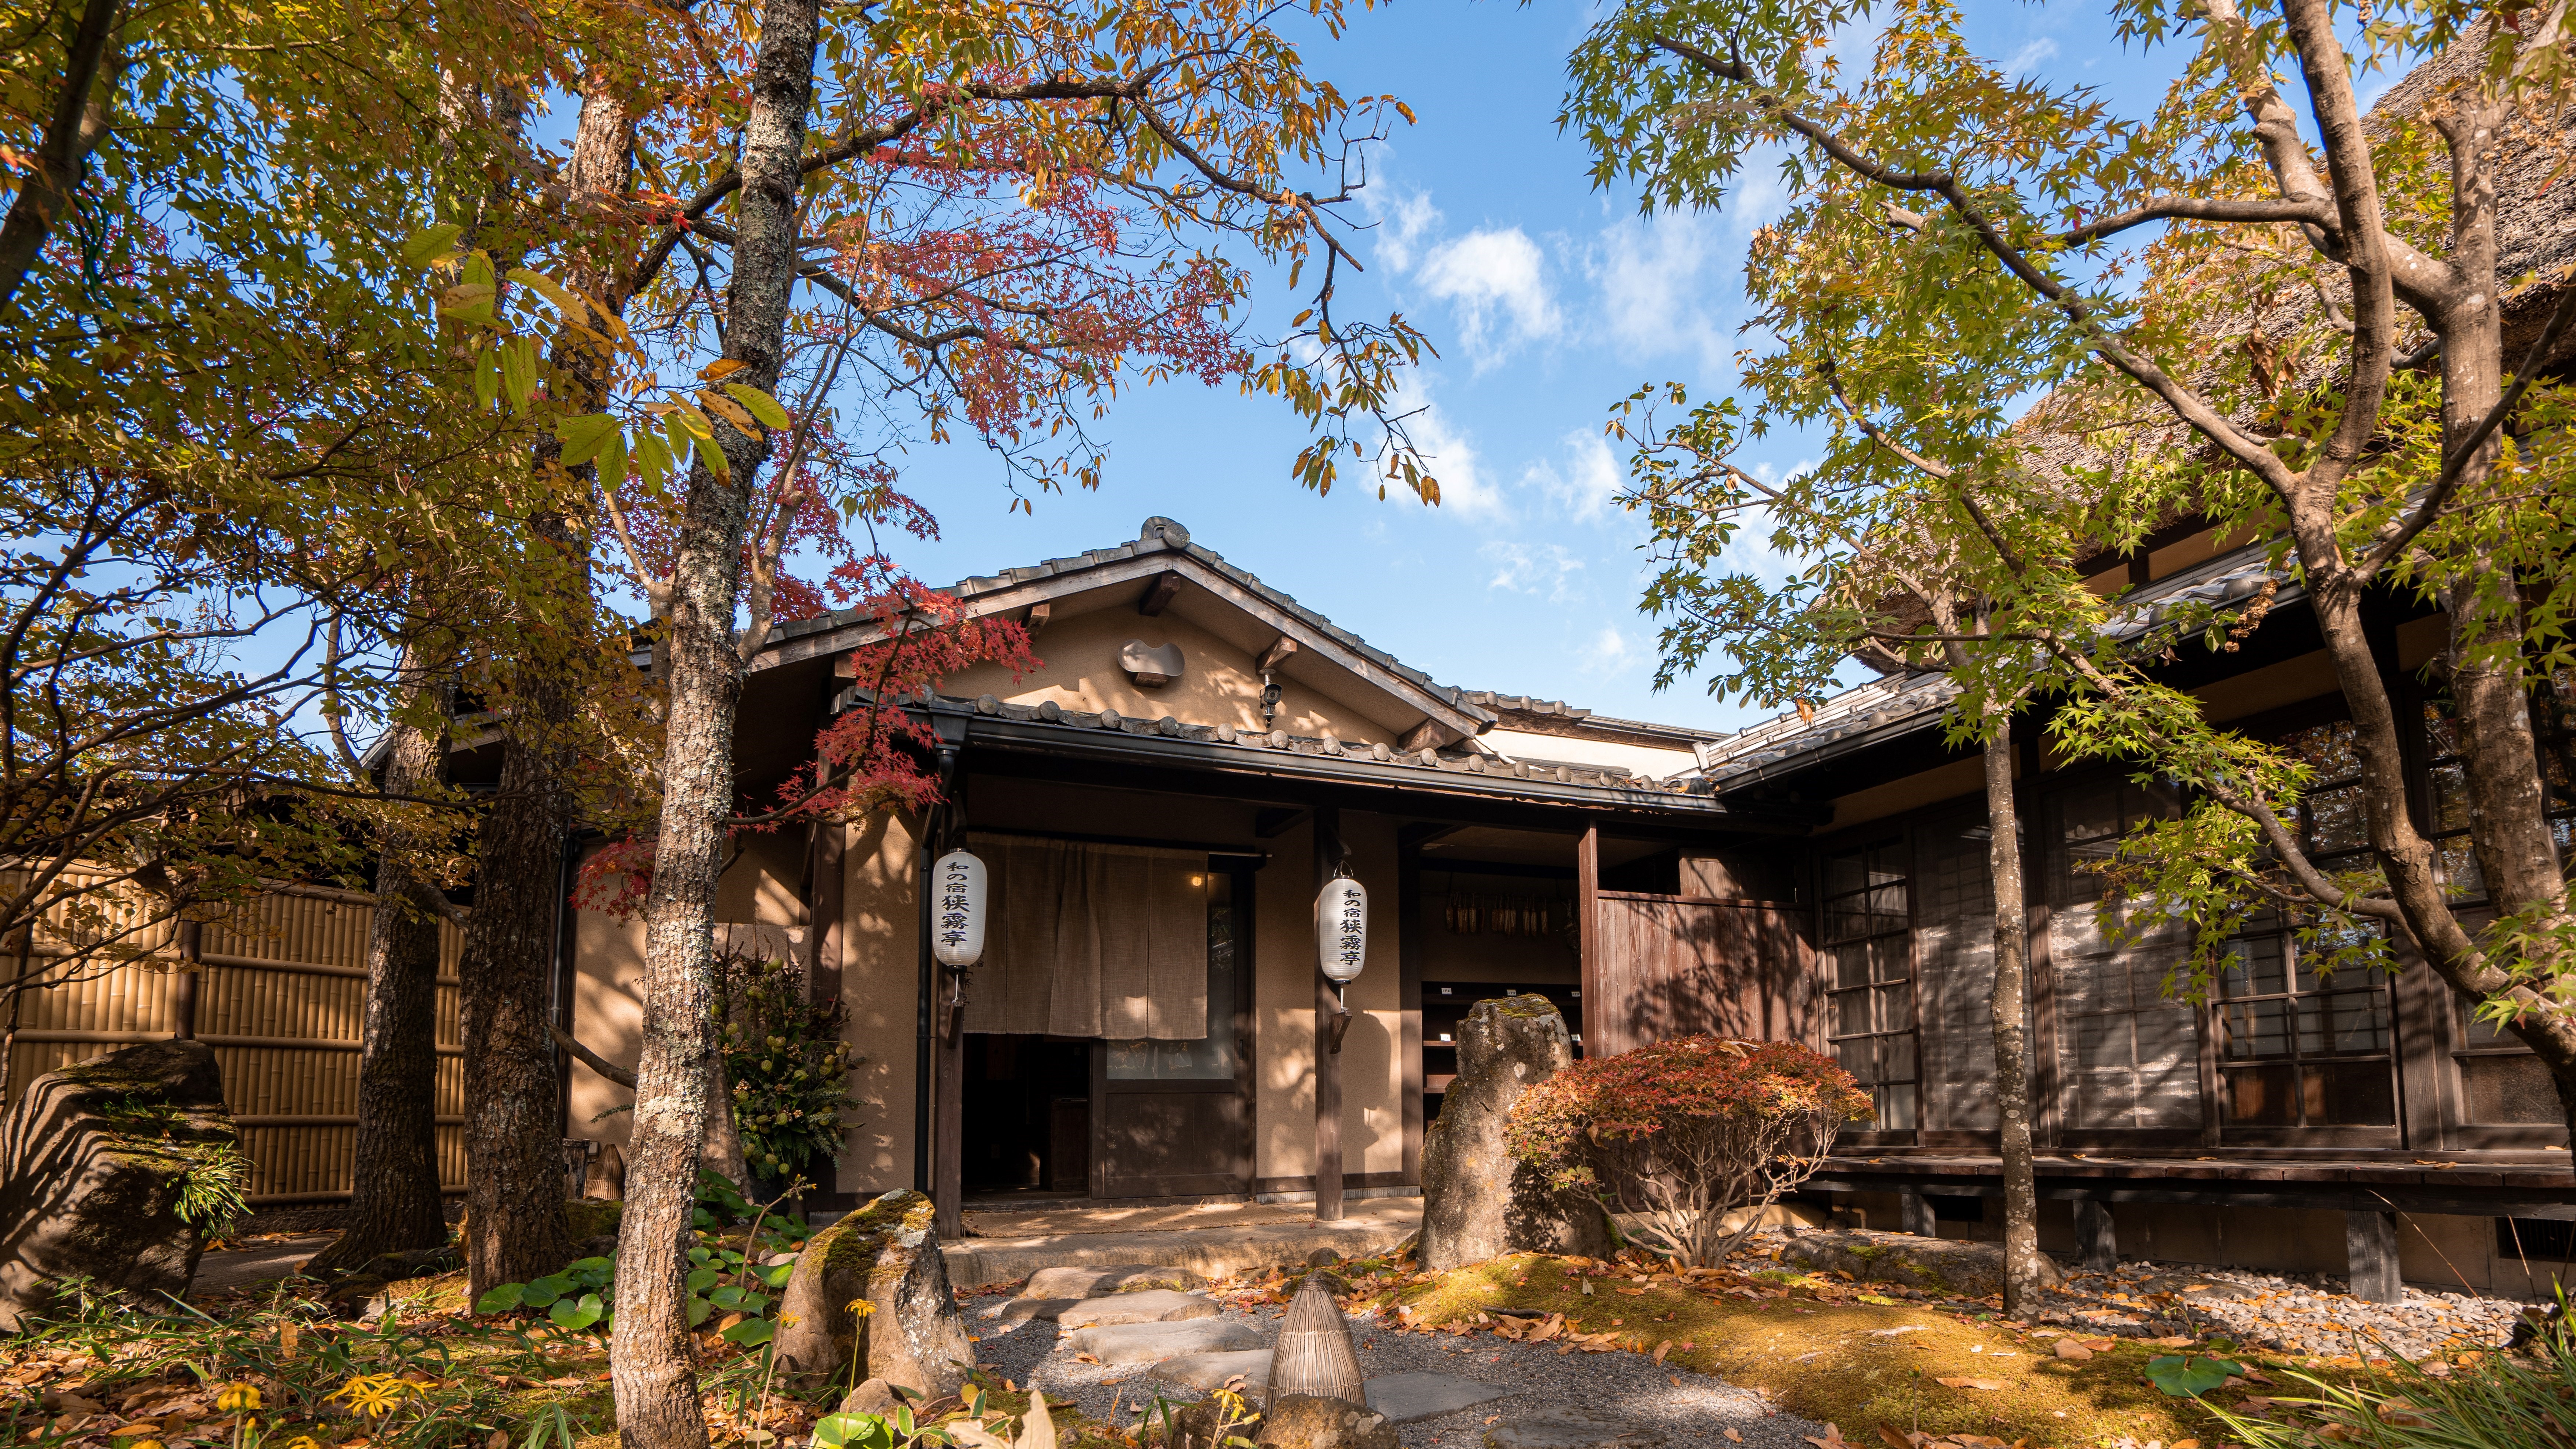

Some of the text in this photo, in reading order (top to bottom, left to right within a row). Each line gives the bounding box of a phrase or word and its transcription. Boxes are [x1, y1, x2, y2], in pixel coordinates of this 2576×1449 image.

[941, 862, 970, 947] 和の宿狭霧亭
[1339, 889, 1362, 966] 和の宿狭霧亭
